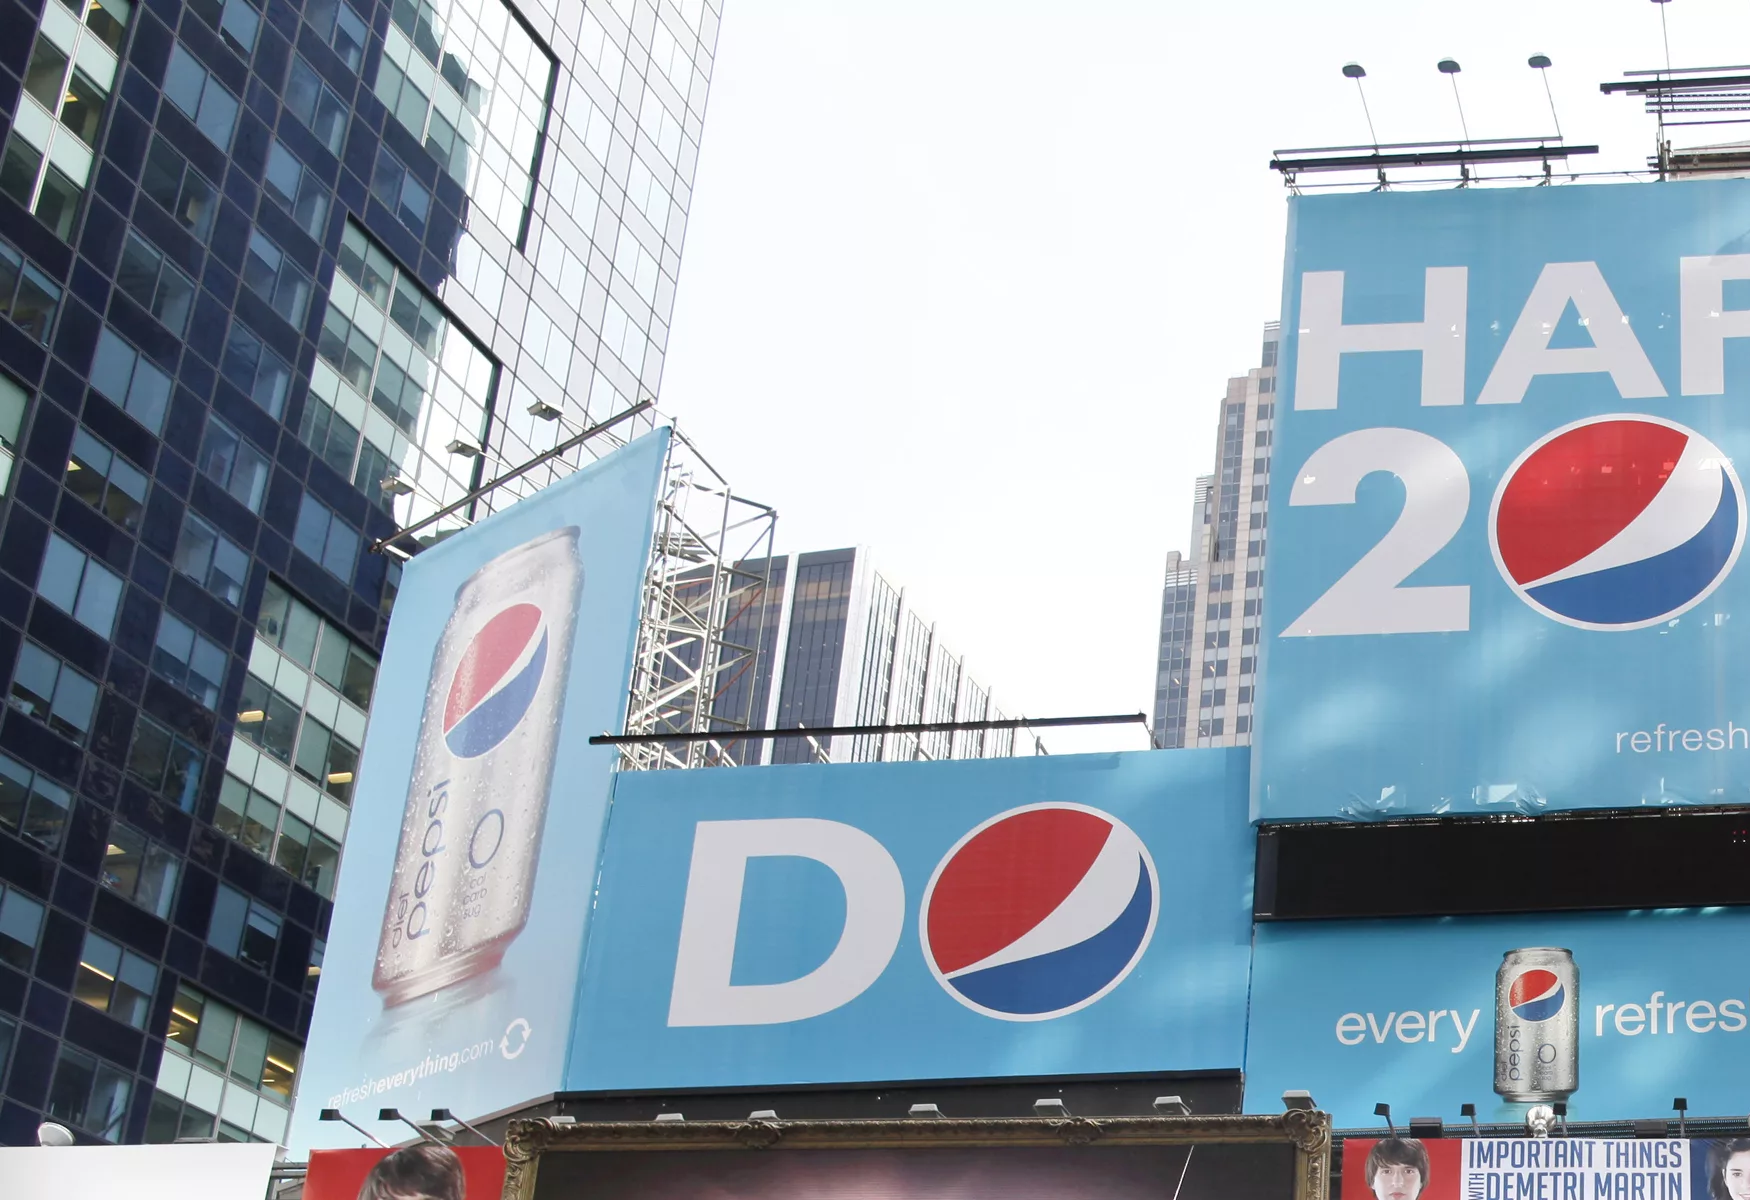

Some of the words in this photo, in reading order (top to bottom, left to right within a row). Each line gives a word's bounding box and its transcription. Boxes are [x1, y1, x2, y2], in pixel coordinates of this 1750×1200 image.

[406, 779, 450, 941] pepsi
[1336, 1008, 1480, 1053] every
[1507, 1025, 1523, 1081] pepsi
[327, 1038, 495, 1109] refresheverything.com
[1469, 1140, 1596, 1169] IMPORTANT
[1603, 1141, 1682, 1169] THINGS
